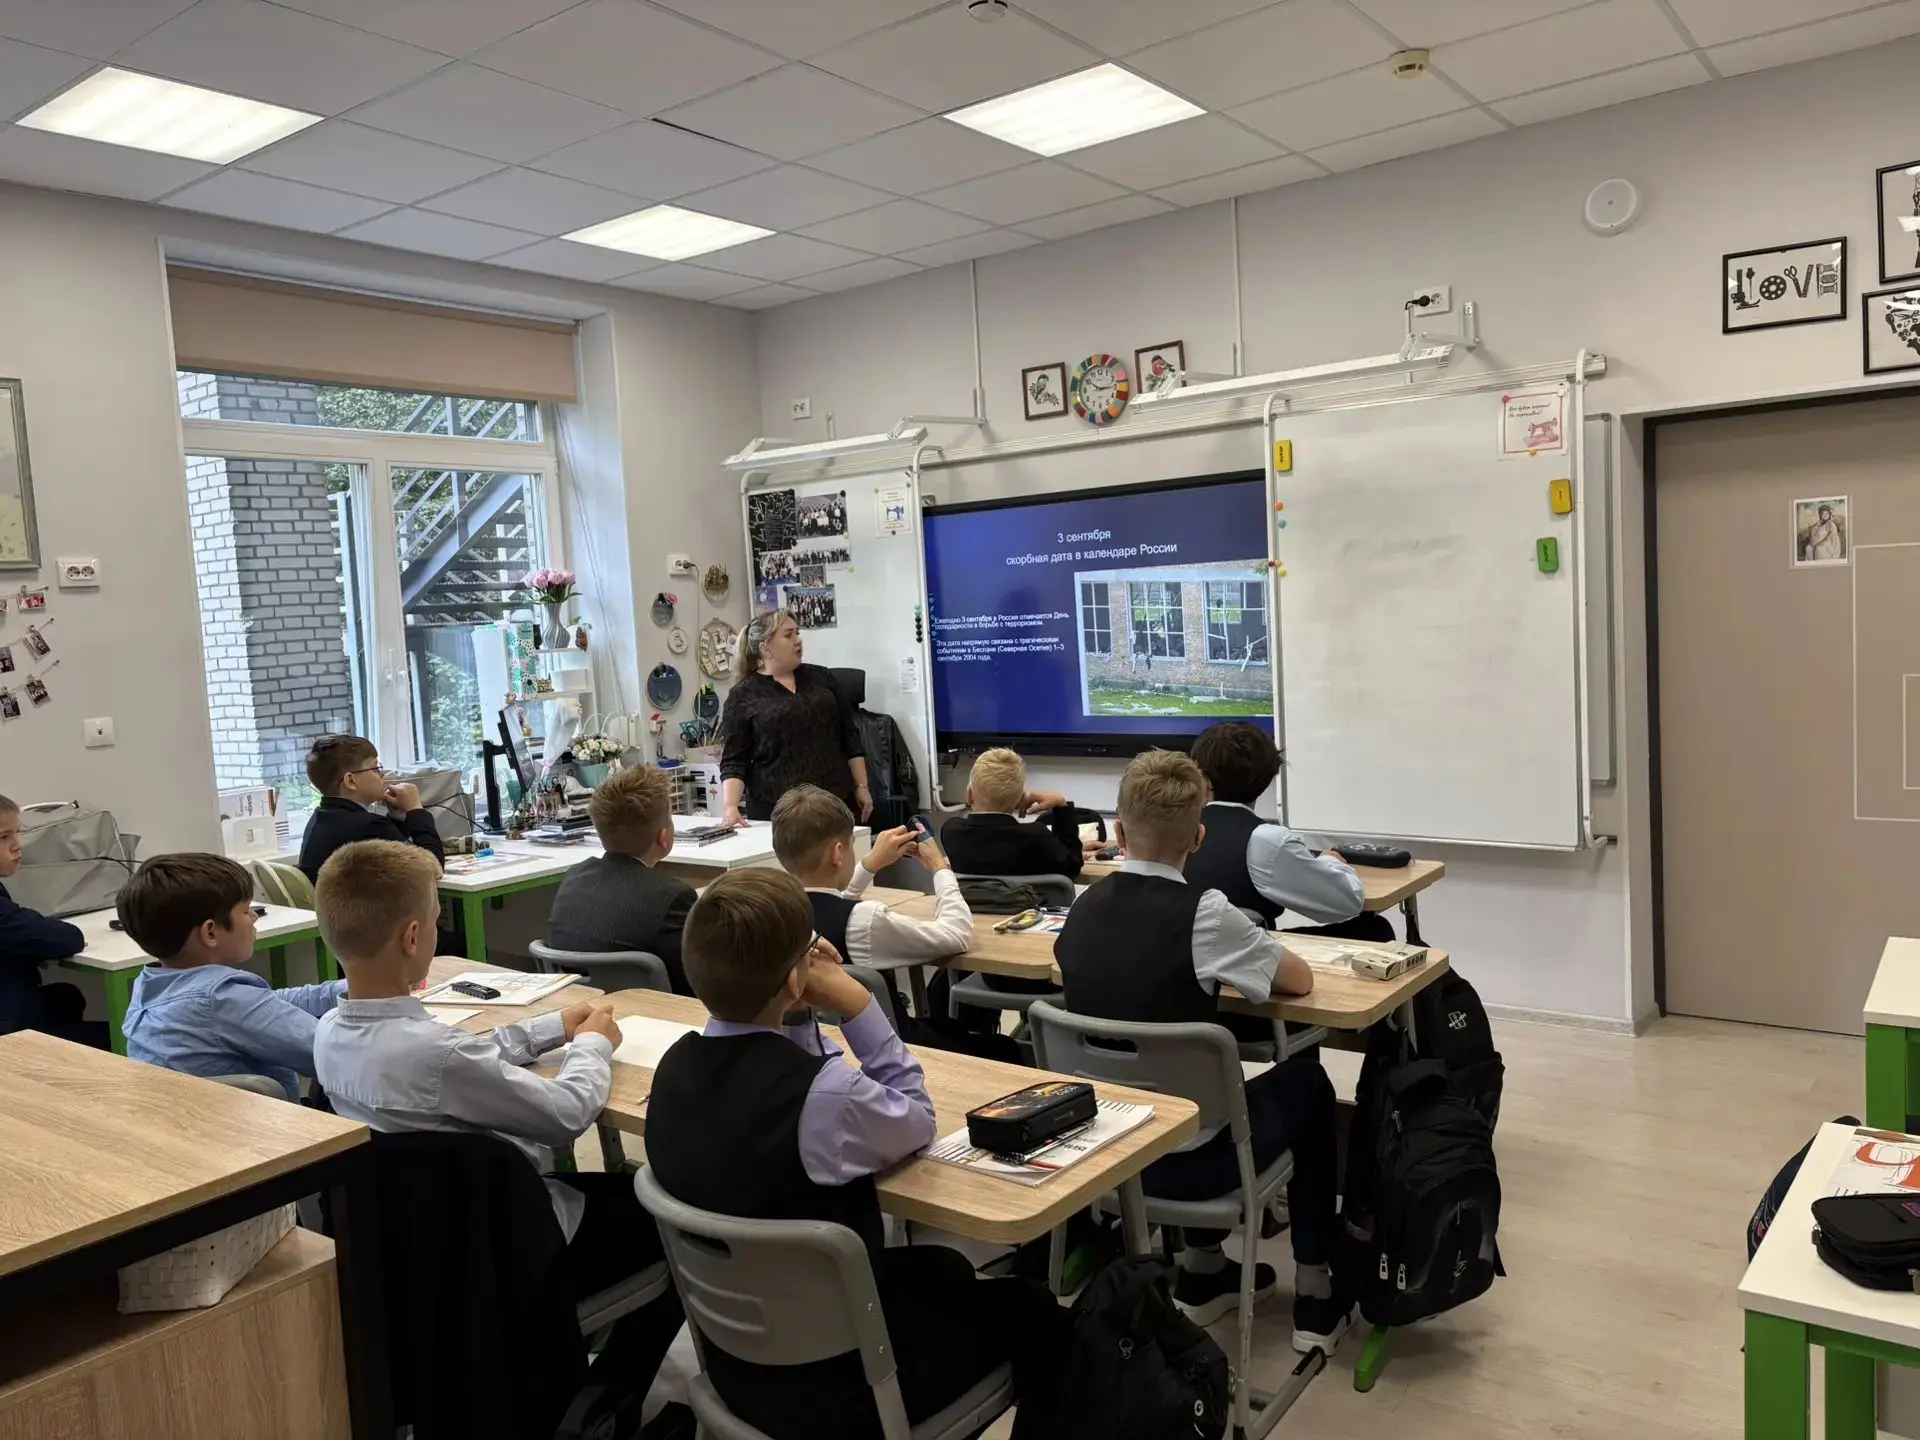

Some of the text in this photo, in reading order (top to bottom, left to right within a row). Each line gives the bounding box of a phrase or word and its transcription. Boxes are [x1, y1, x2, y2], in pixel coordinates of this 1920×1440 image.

[1057, 529, 1111, 543] 3 сентября
[1006, 543, 1178, 566] скорбная дата в календаре России
[967, 615, 992, 623] сентября
[979, 621, 999, 629] борьбе
[997, 645, 1028, 654] (Северная
[1028, 643, 1053, 652] Осетия)
